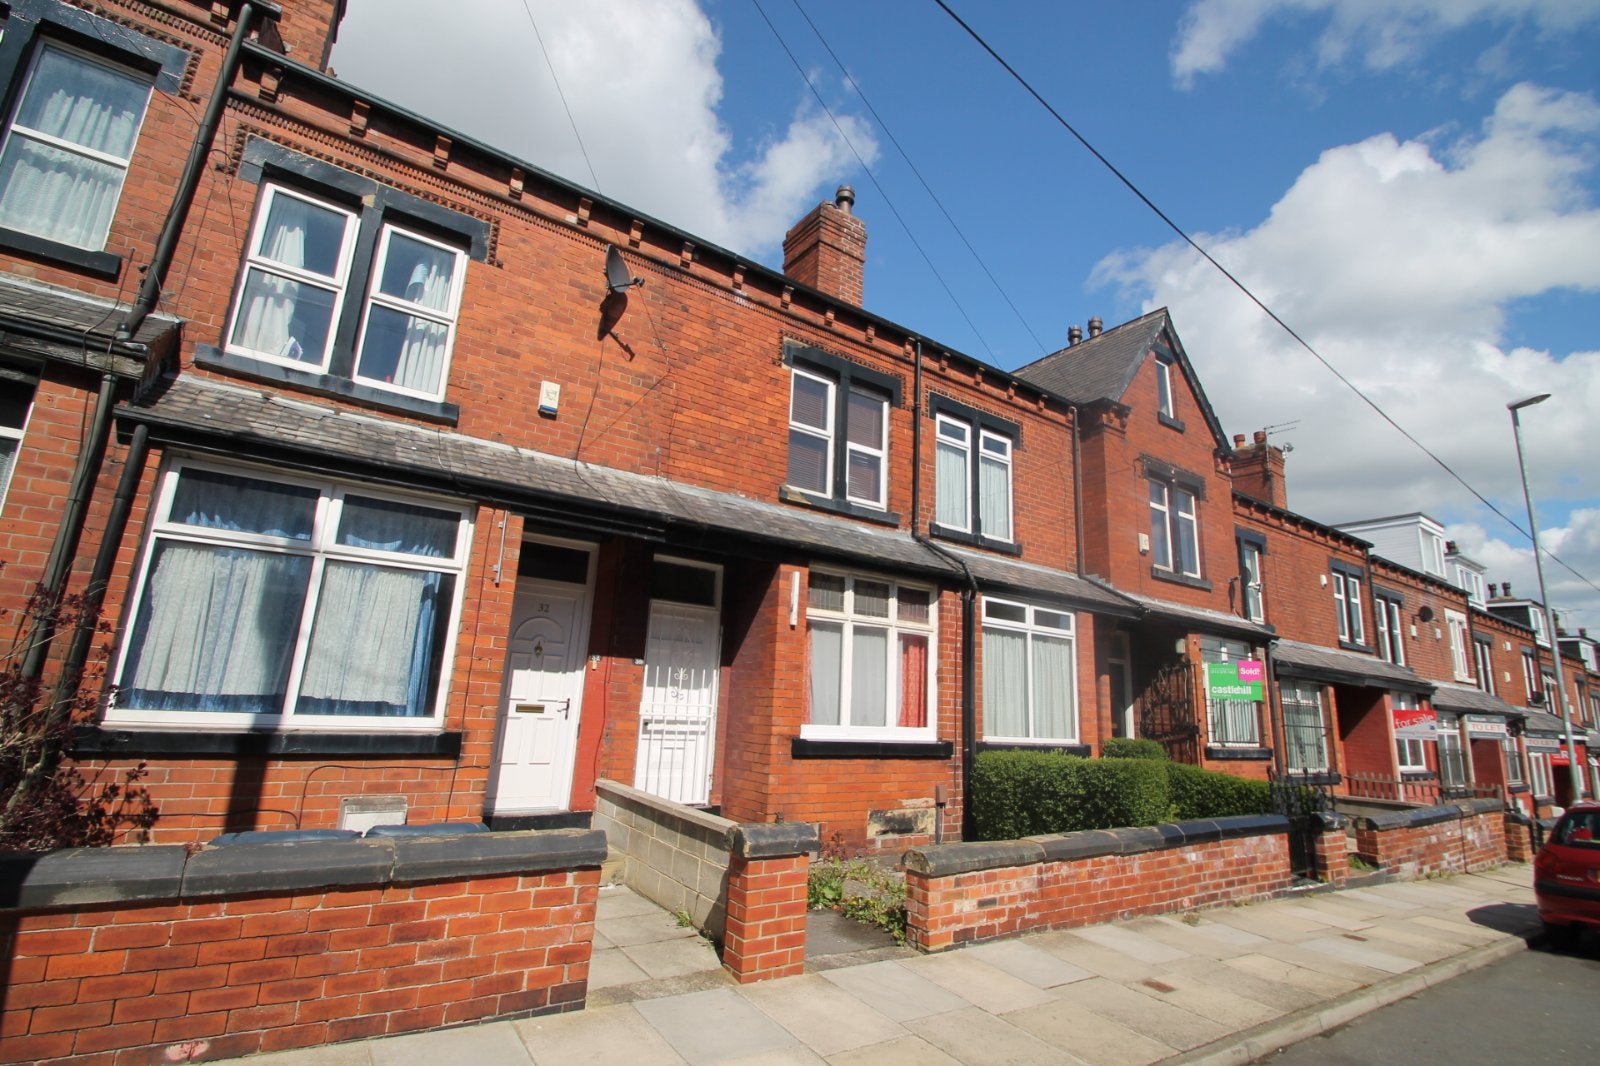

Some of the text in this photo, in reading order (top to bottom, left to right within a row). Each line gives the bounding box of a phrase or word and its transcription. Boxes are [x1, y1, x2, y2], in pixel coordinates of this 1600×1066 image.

[537, 603, 550, 613] 32
[1211, 686, 1252, 695] castlehill
[1395, 714, 1434, 729] for sale
[1472, 723, 1502, 731] TO LET
